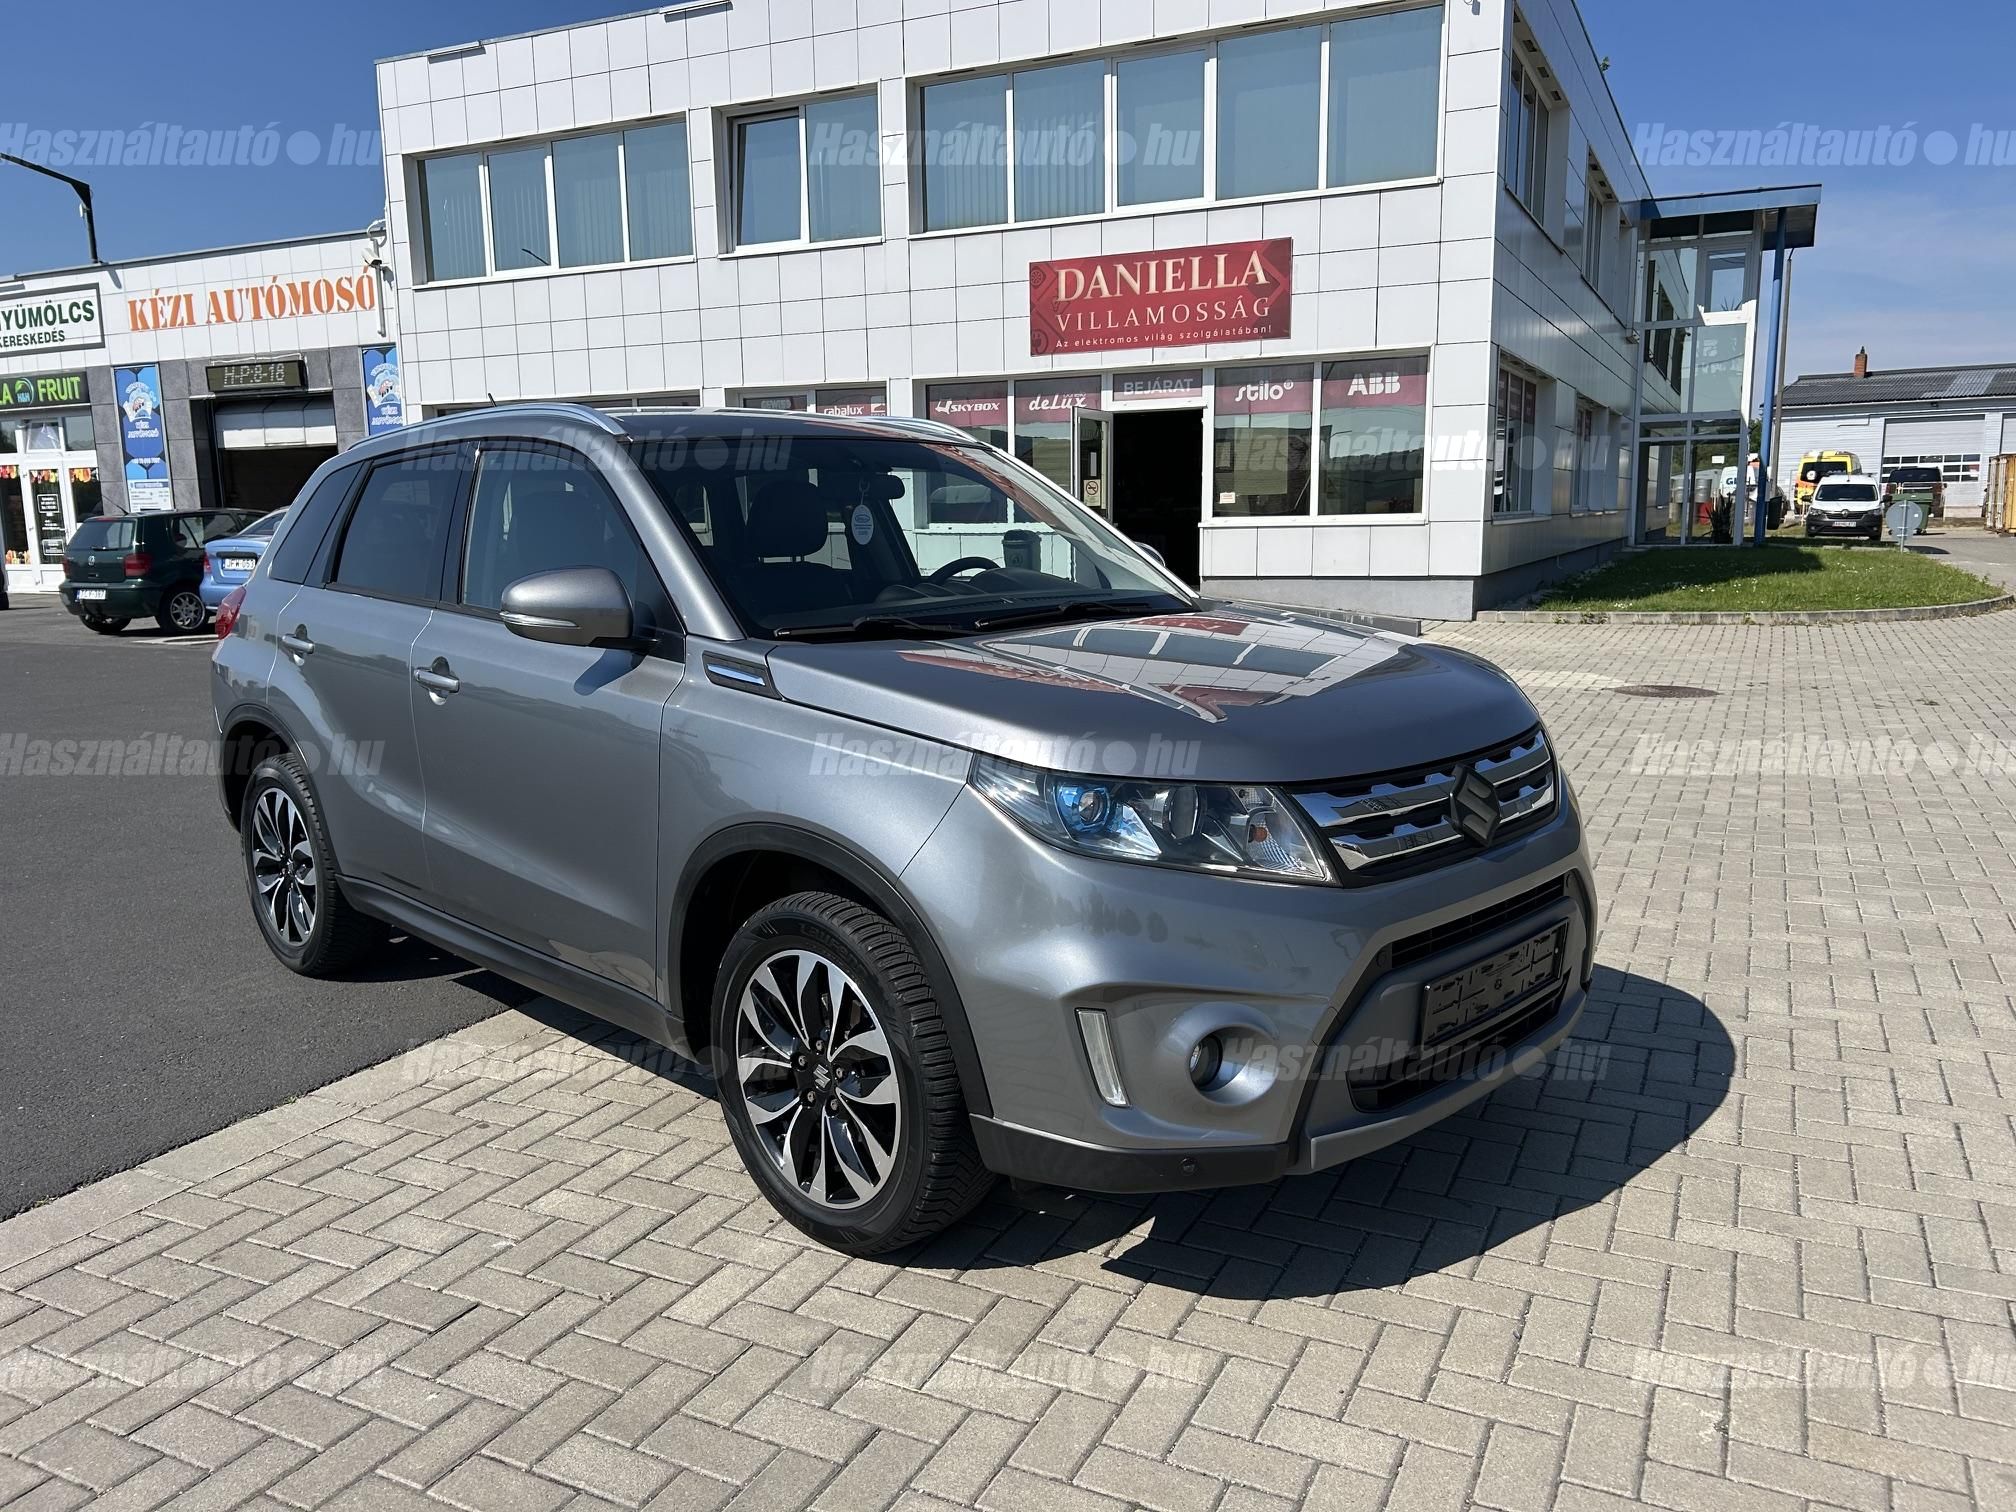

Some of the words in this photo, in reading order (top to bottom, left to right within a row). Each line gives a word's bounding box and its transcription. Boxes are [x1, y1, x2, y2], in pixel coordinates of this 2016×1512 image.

[1055, 250, 1271, 303] DANIELLA
[128, 288, 196, 332] KÉZI
[206, 266, 376, 324] AUTÓMOSÓ
[0, 300, 95, 332] YÜMÖLCS
[1055, 295, 1271, 332] VILLAMOSSÁG
[1055, 339, 1069, 348] Az
[1074, 335, 1139, 347] elektromos
[1144, 330, 1173, 342] világ
[1179, 324, 1272, 340] szolgálatában!
[36, 376, 81, 402] FRUIT
[1123, 376, 1194, 396] BEJÁRAT
[1347, 372, 1401, 396] ABB
[950, 402, 1001, 413] SKYBOX
